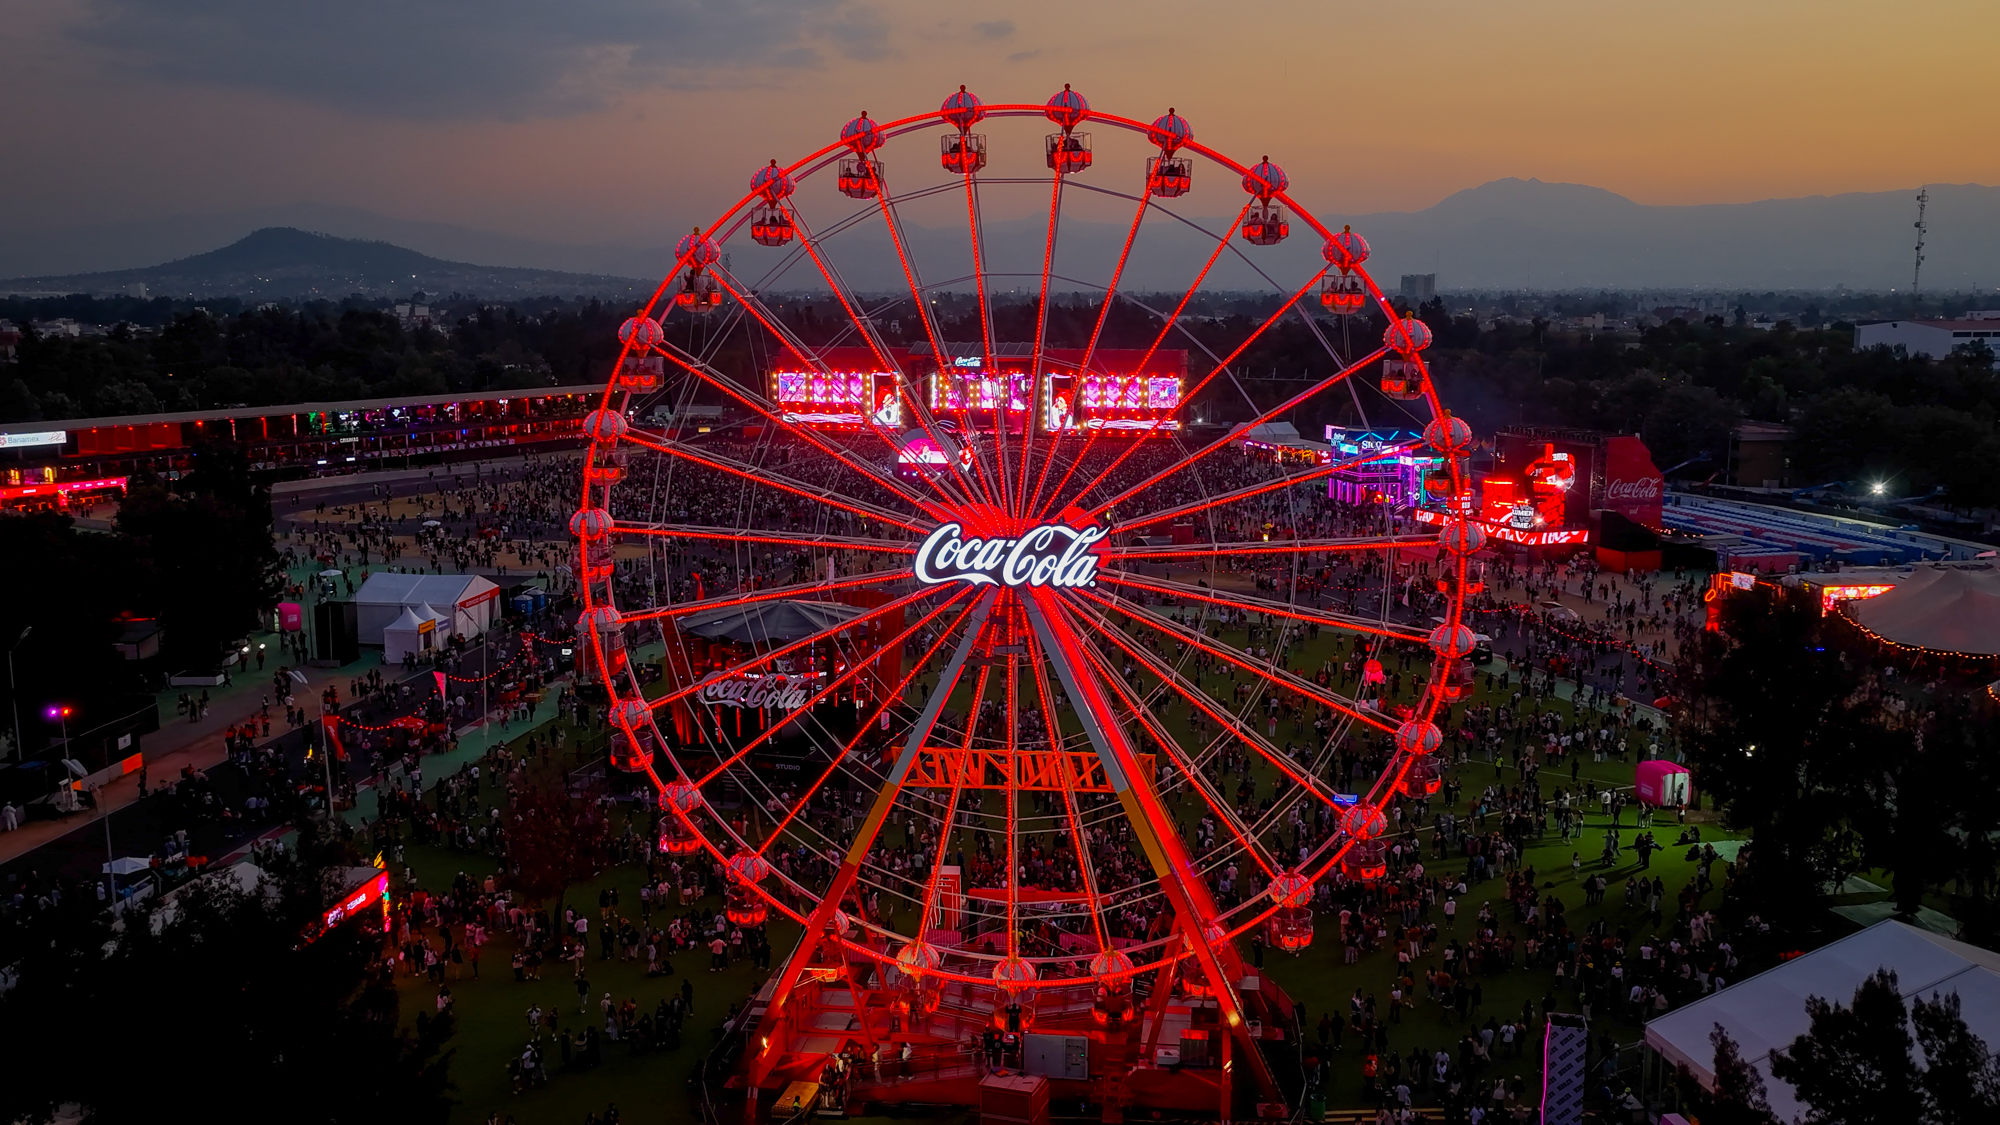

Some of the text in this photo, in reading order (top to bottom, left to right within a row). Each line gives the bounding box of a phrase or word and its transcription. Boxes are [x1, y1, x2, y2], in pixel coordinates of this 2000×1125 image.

[7, 436, 40, 444] Banamex
[1607, 477, 1661, 500] Coca-Cola
[914, 523, 1111, 587] Coca-Cola
[697, 670, 813, 709] Coca-Cola
[775, 763, 801, 771] STUDIO
